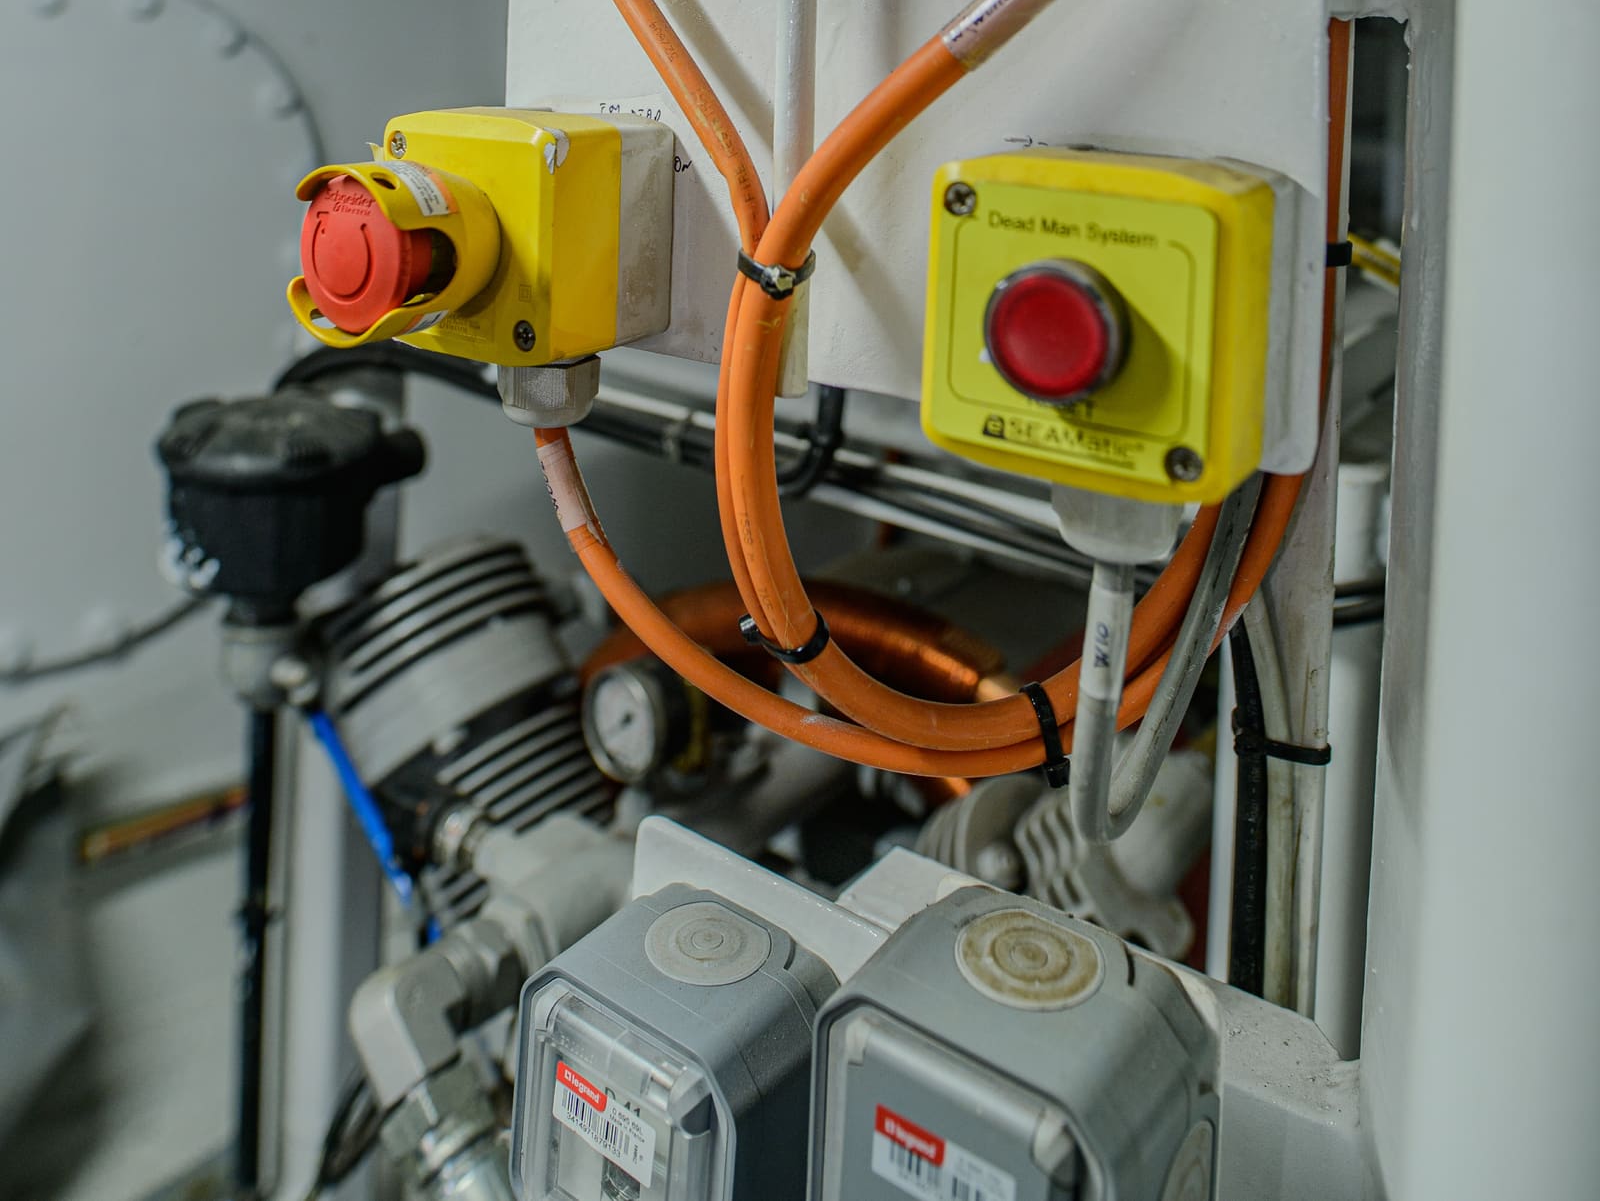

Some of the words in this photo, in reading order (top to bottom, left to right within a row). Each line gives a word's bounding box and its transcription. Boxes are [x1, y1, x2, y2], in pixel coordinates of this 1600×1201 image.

[325, 190, 376, 207] Schneider
[988, 210, 1035, 232] Dead
[1041, 217, 1081, 238] Man
[1086, 222, 1159, 248] System
[571, 1077, 600, 1104] legrand
